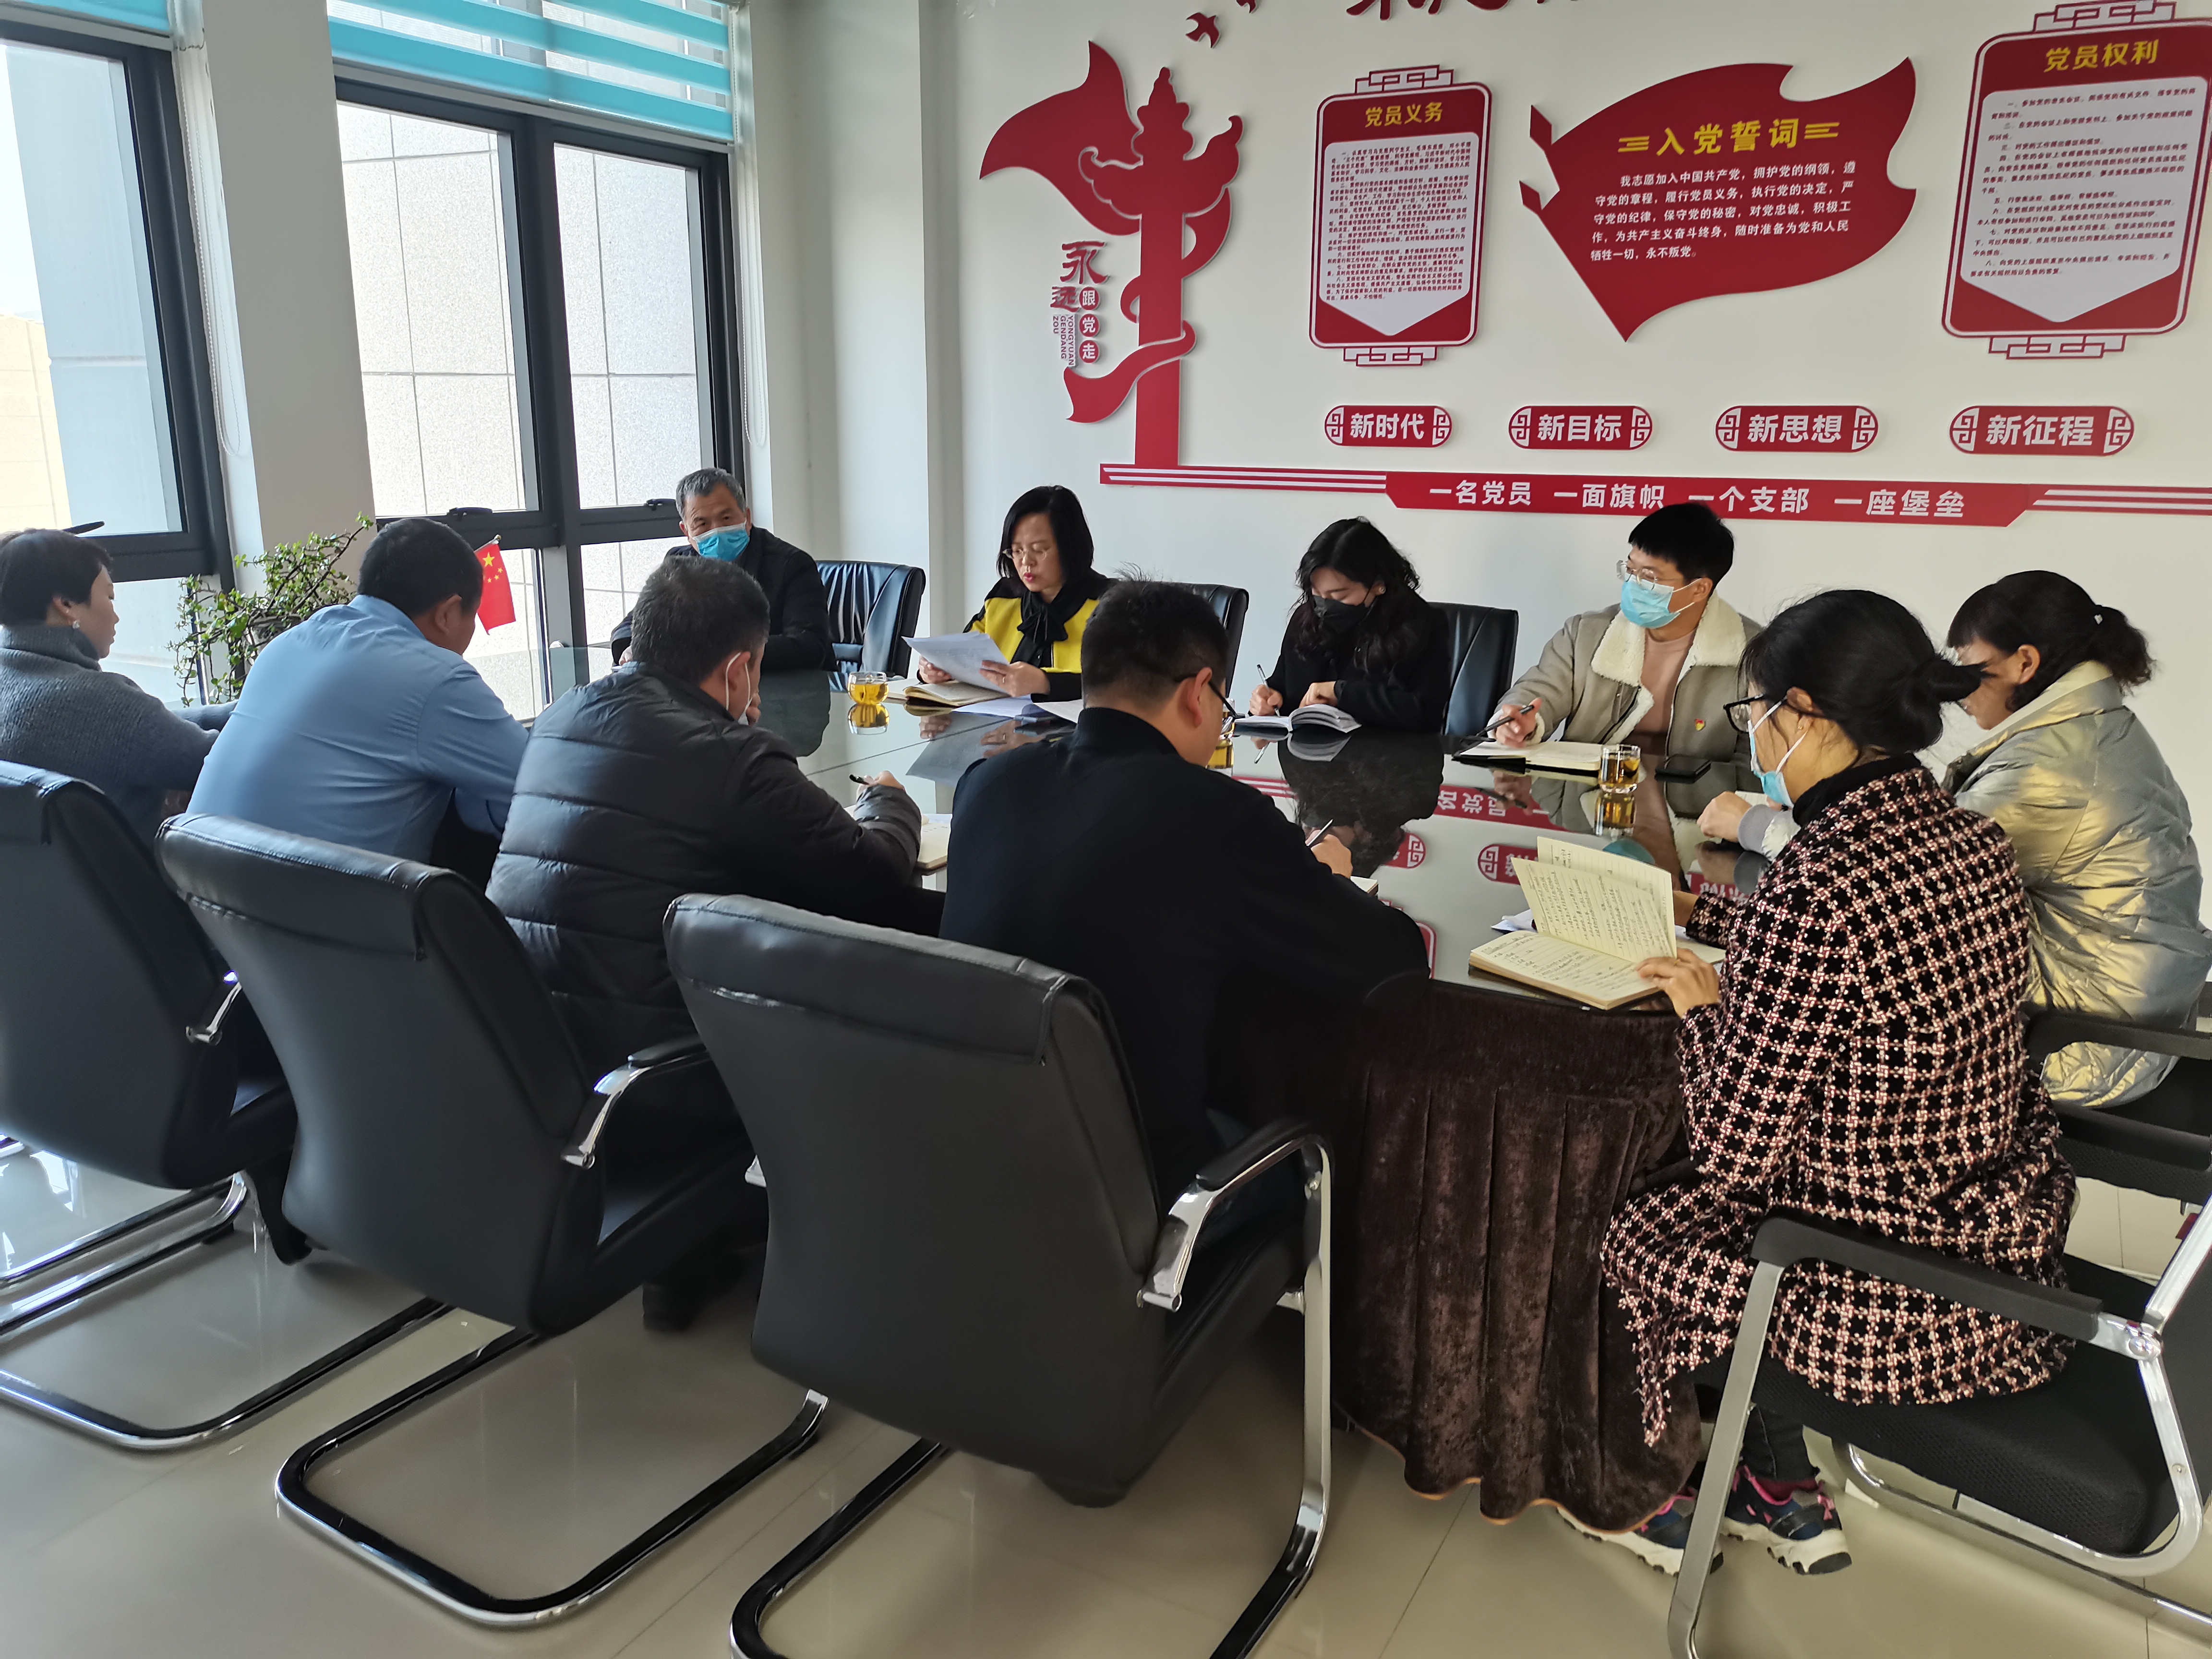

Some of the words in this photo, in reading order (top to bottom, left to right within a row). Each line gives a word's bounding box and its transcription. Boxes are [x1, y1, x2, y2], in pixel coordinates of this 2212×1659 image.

[2044, 39, 2158, 72] 党员权利
[1366, 102, 1442, 127] 党员义务
[1656, 119, 1799, 156] 入党誓词
[1082, 290, 1096, 360] 跟党走
[1350, 413, 1424, 439] 新时代
[1538, 414, 1622, 442] 新目标
[1747, 414, 1842, 443] 新思想
[1986, 415, 2094, 446] 新征程
[1430, 480, 1531, 505] 一名党员
[1554, 484, 1664, 509] 一面旗帜
[1688, 486, 1809, 514] 一个支部
[1834, 489, 1964, 517] 一座堡垒
